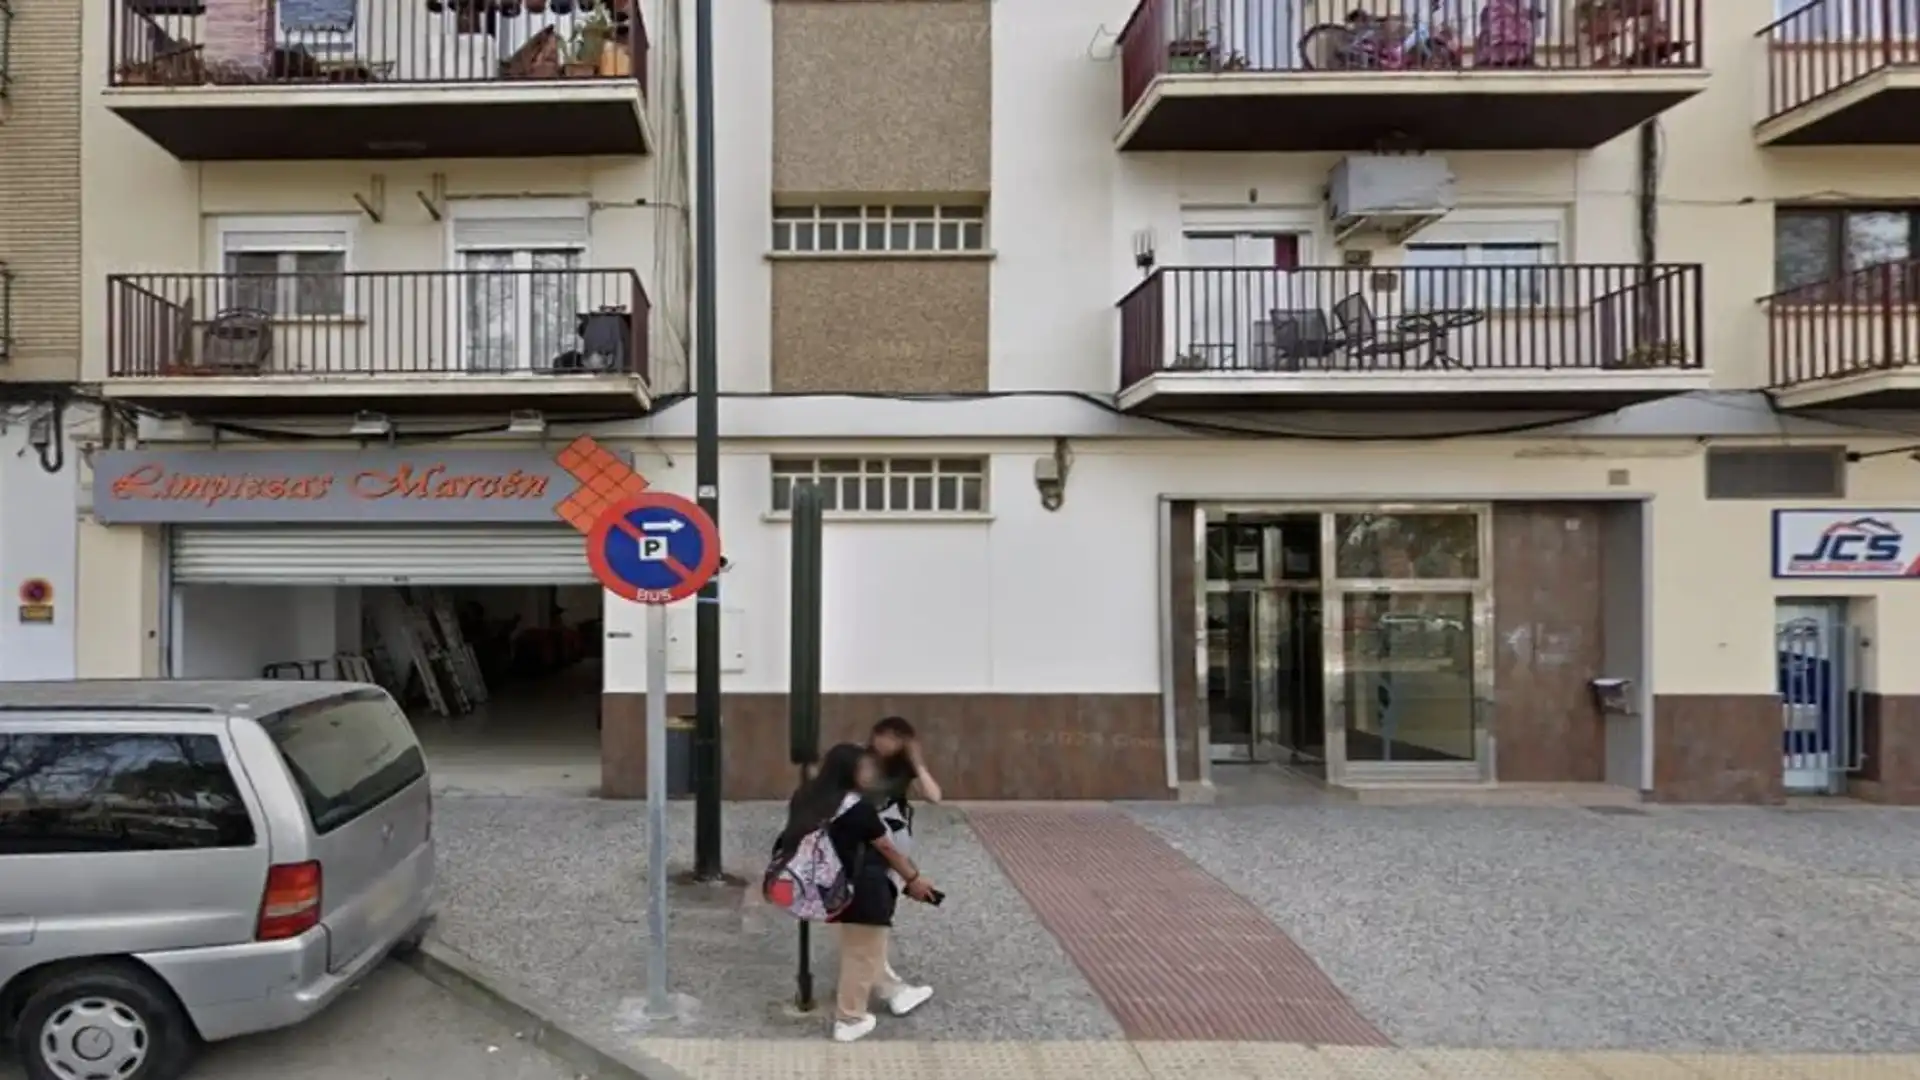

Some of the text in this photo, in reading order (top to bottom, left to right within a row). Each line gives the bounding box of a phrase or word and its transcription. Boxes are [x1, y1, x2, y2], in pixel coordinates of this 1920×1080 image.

[347, 461, 549, 500] Marcén
[644, 539, 660, 557] P
[1791, 533, 1902, 561] JCS
[636, 588, 672, 602] BUS
